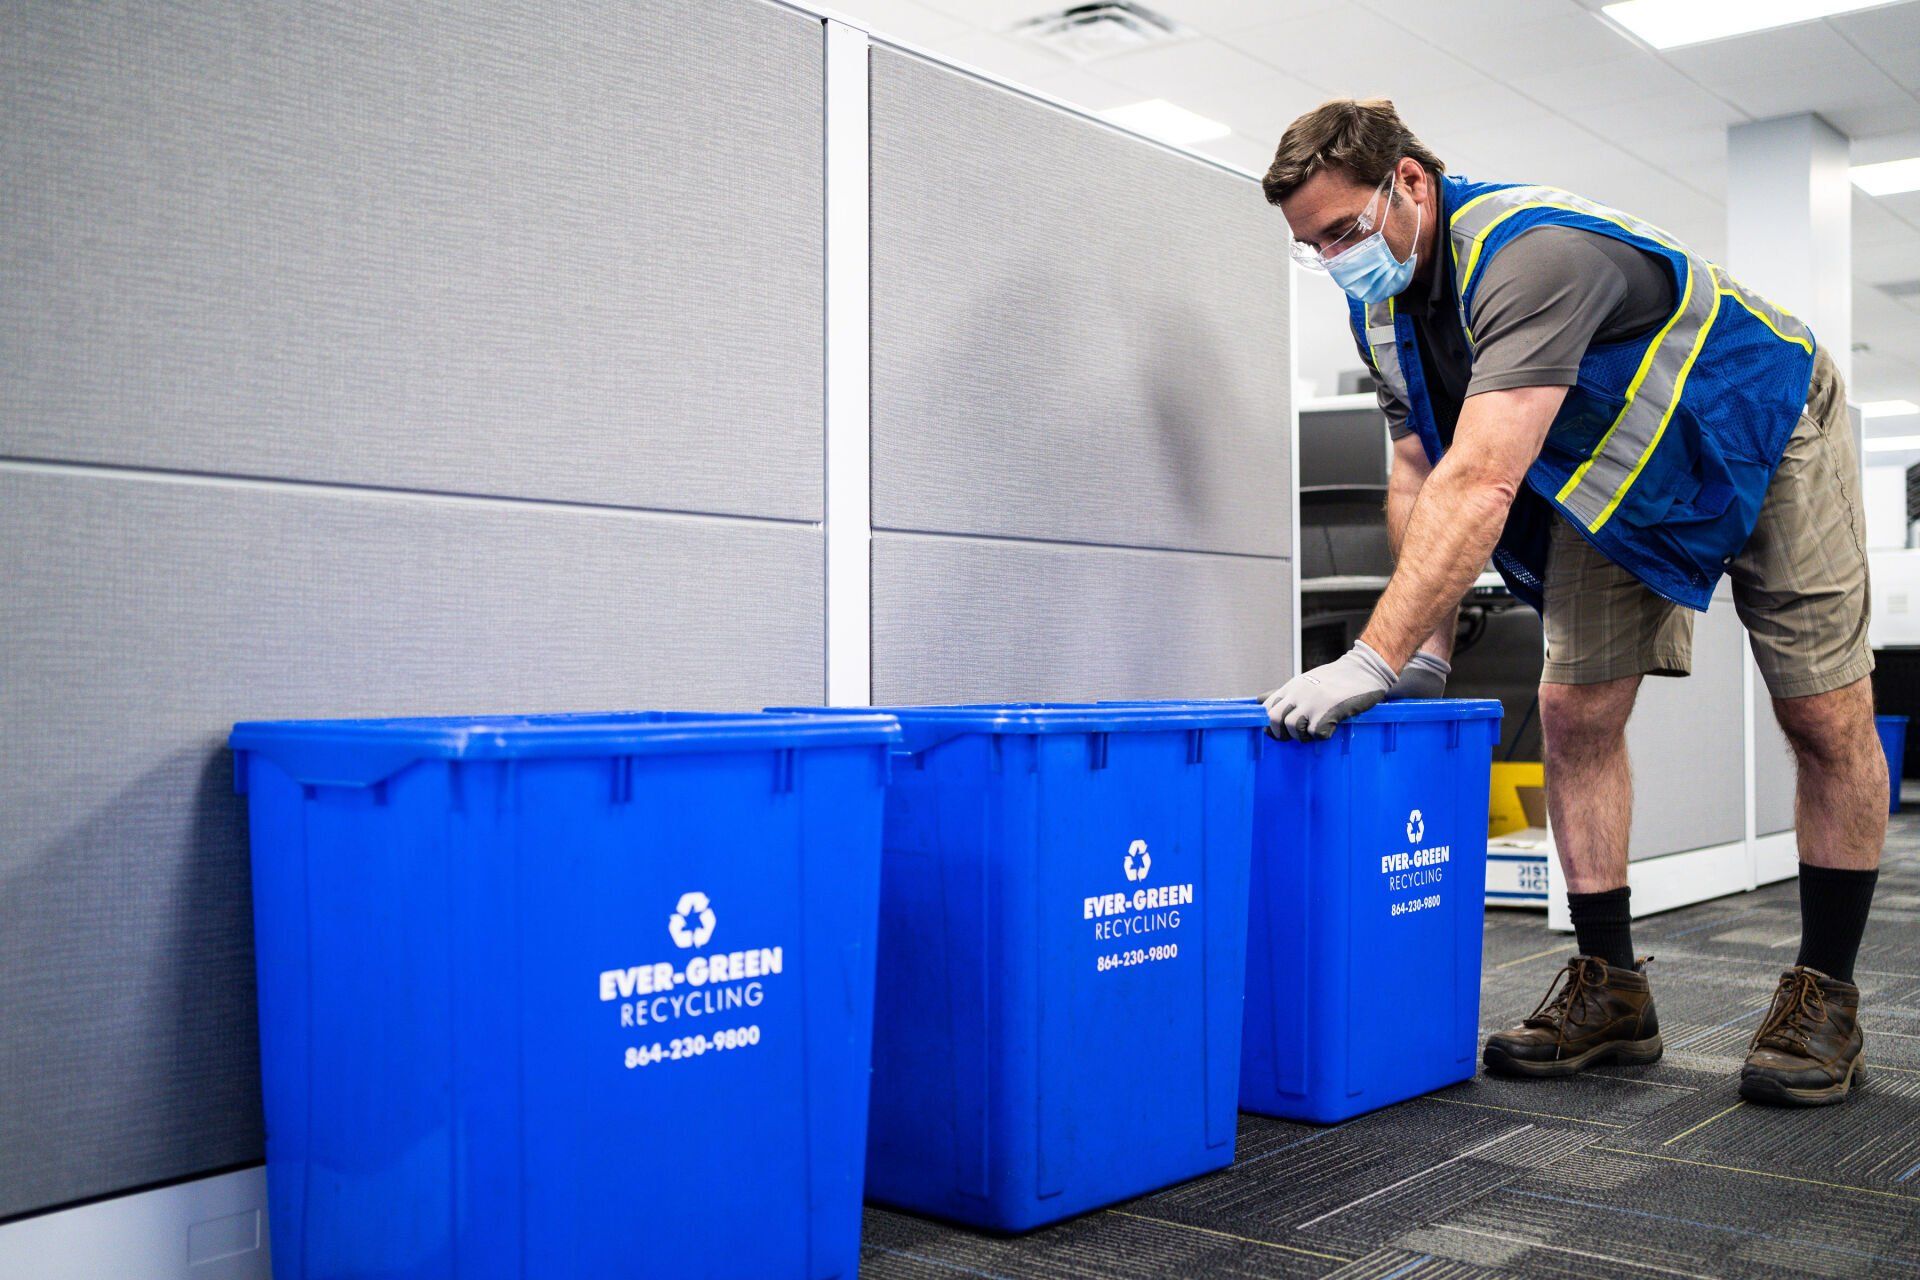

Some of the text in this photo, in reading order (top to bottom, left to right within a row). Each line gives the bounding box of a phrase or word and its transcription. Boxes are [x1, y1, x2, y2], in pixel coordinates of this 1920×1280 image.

[1381, 845, 1450, 874] EVER-GREEN
[1389, 867, 1443, 892] RECYCLING
[1083, 883, 1193, 921] EVER-GREEN
[1391, 894, 1441, 917] 864-230-9800
[1095, 910, 1181, 940] RECYCLING
[1096, 943, 1178, 972] 864-230-9800
[599, 946, 783, 1002] EVER-GREEN
[620, 981, 764, 1027] RECYCLING
[624, 1024, 761, 1069] 864-230-9800
